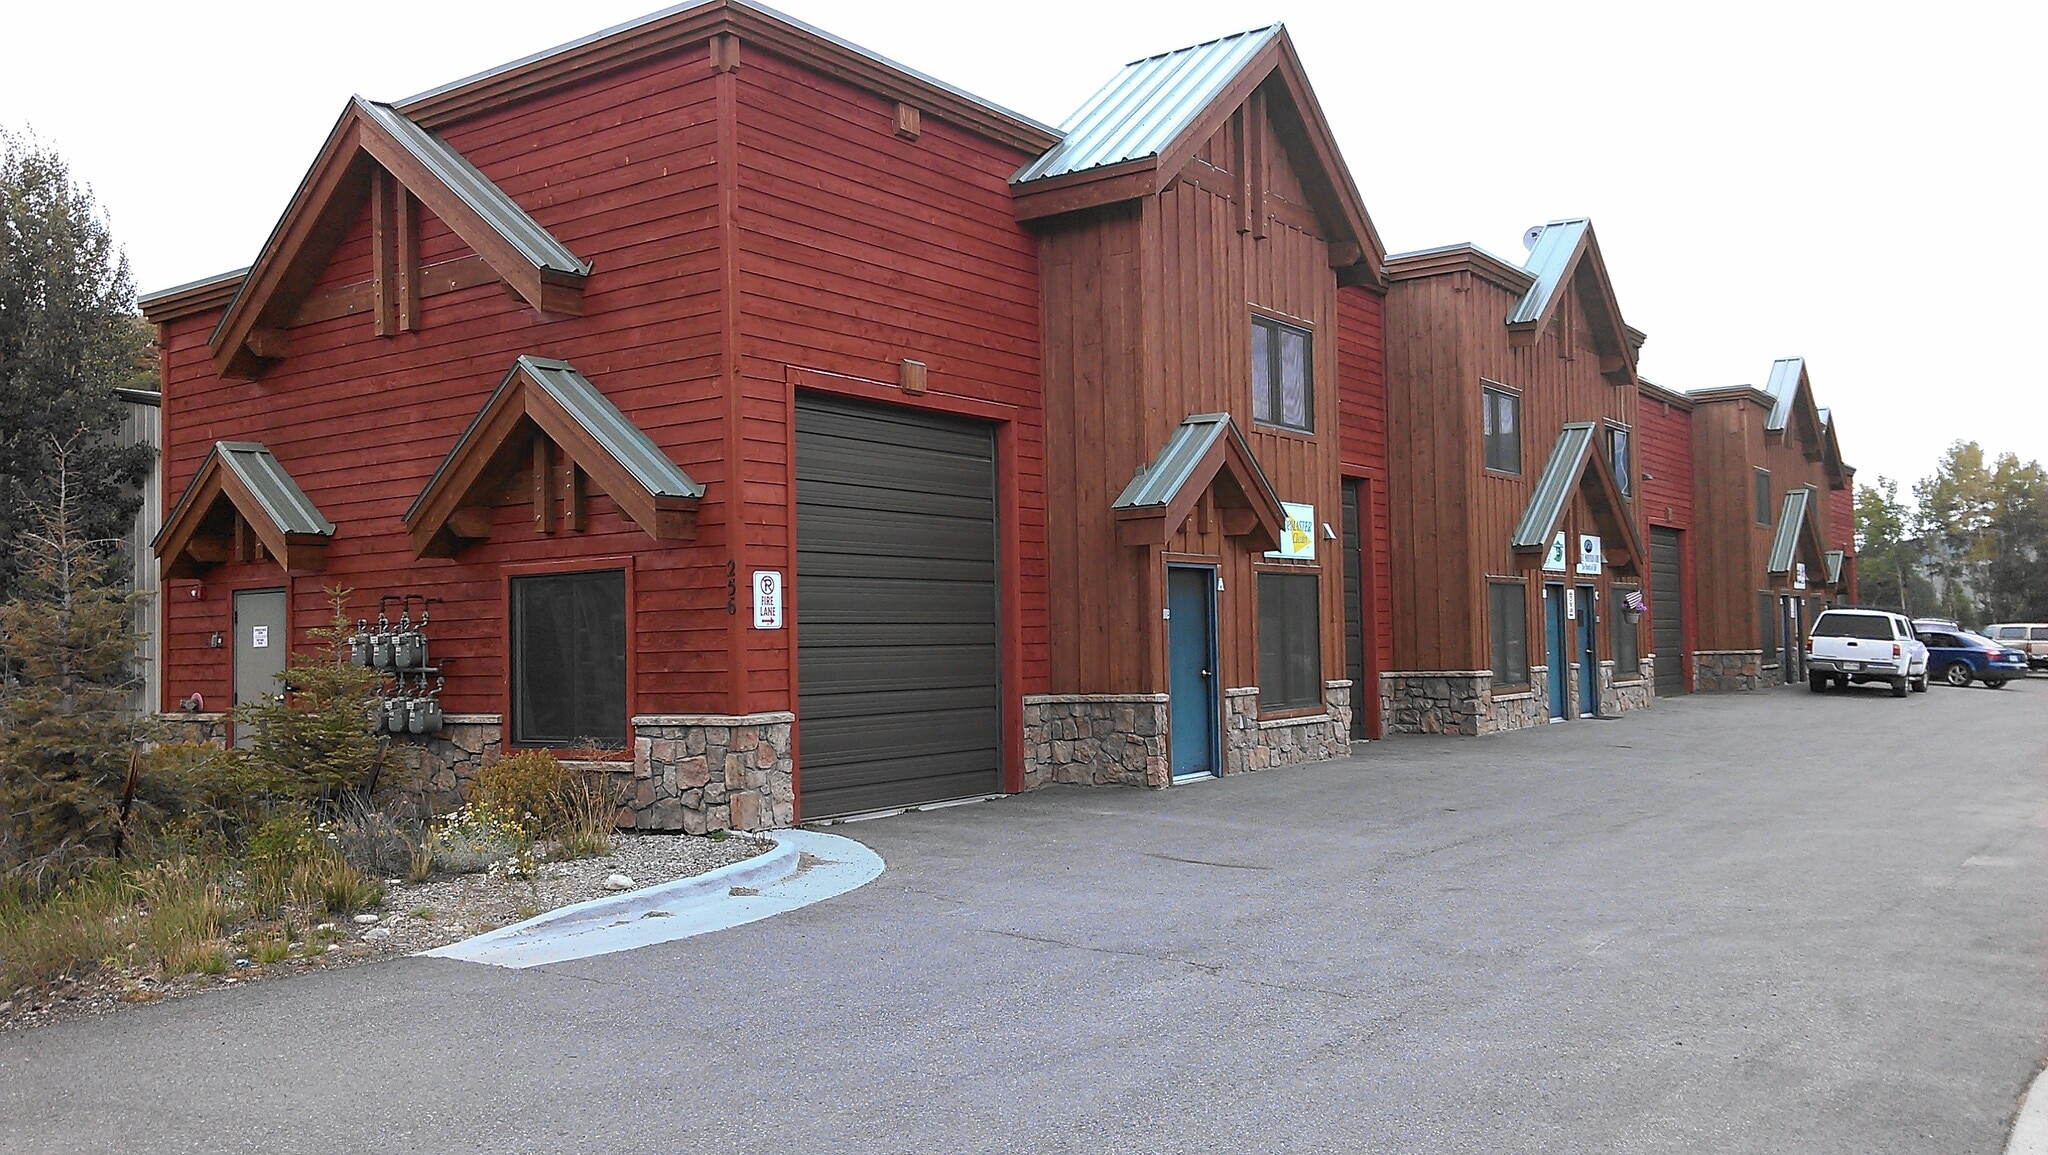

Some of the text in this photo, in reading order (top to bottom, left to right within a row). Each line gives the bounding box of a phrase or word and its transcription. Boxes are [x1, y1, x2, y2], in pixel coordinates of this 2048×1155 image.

[727, 560, 736, 615] 256
[761, 596, 774, 606] FIRE
[760, 606, 776, 617] LANE
